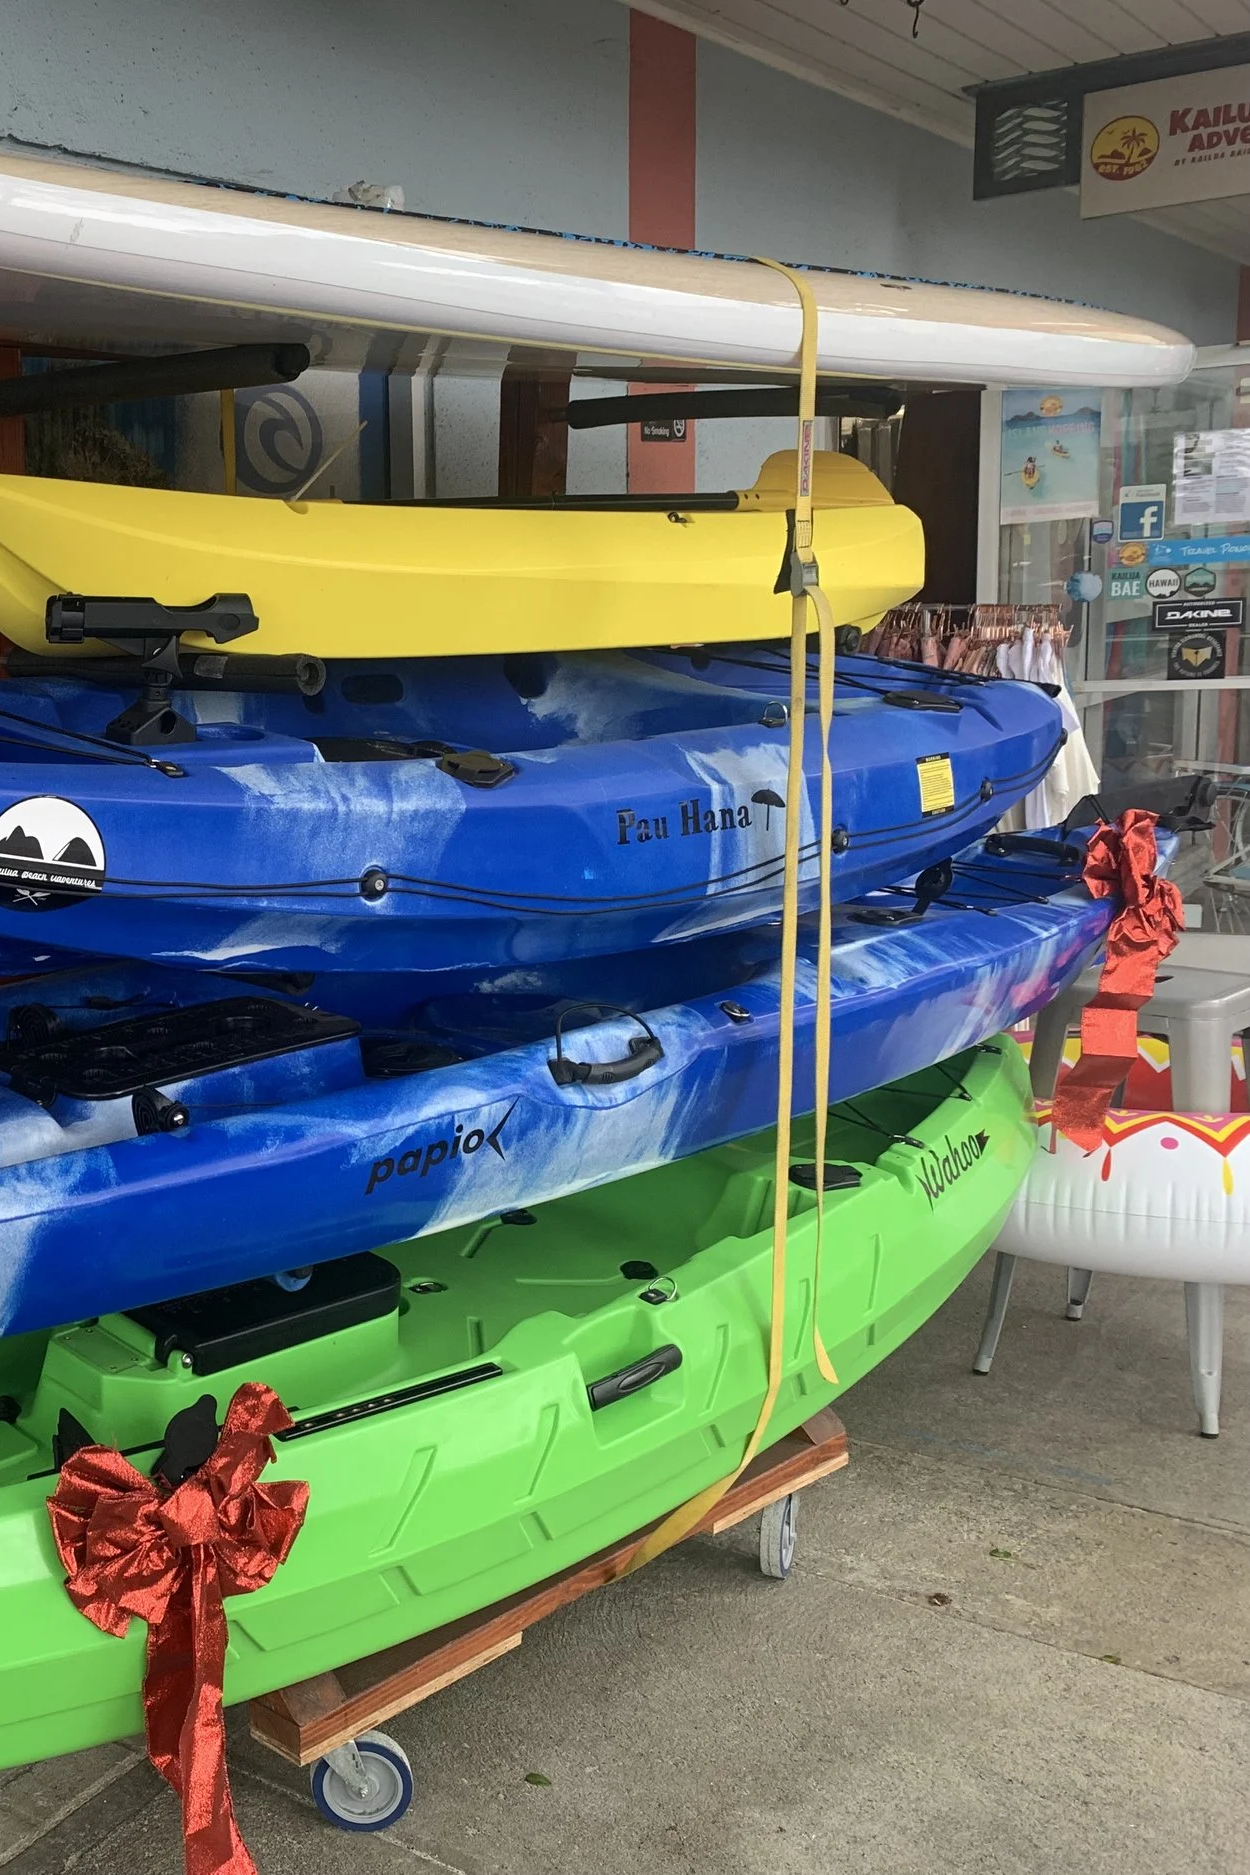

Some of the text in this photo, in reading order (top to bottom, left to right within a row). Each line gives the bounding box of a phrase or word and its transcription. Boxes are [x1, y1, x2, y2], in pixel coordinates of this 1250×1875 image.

[1111, 571, 1141, 580] KAILUA
[1149, 579, 1179, 588] HAWAII
[1111, 580, 1141, 597] BAE
[1165, 608, 1233, 620] DAKINE
[616, 798, 753, 845] Pau Hana
[365, 1124, 485, 1195] papio
[915, 1135, 980, 1213] Wahoo
